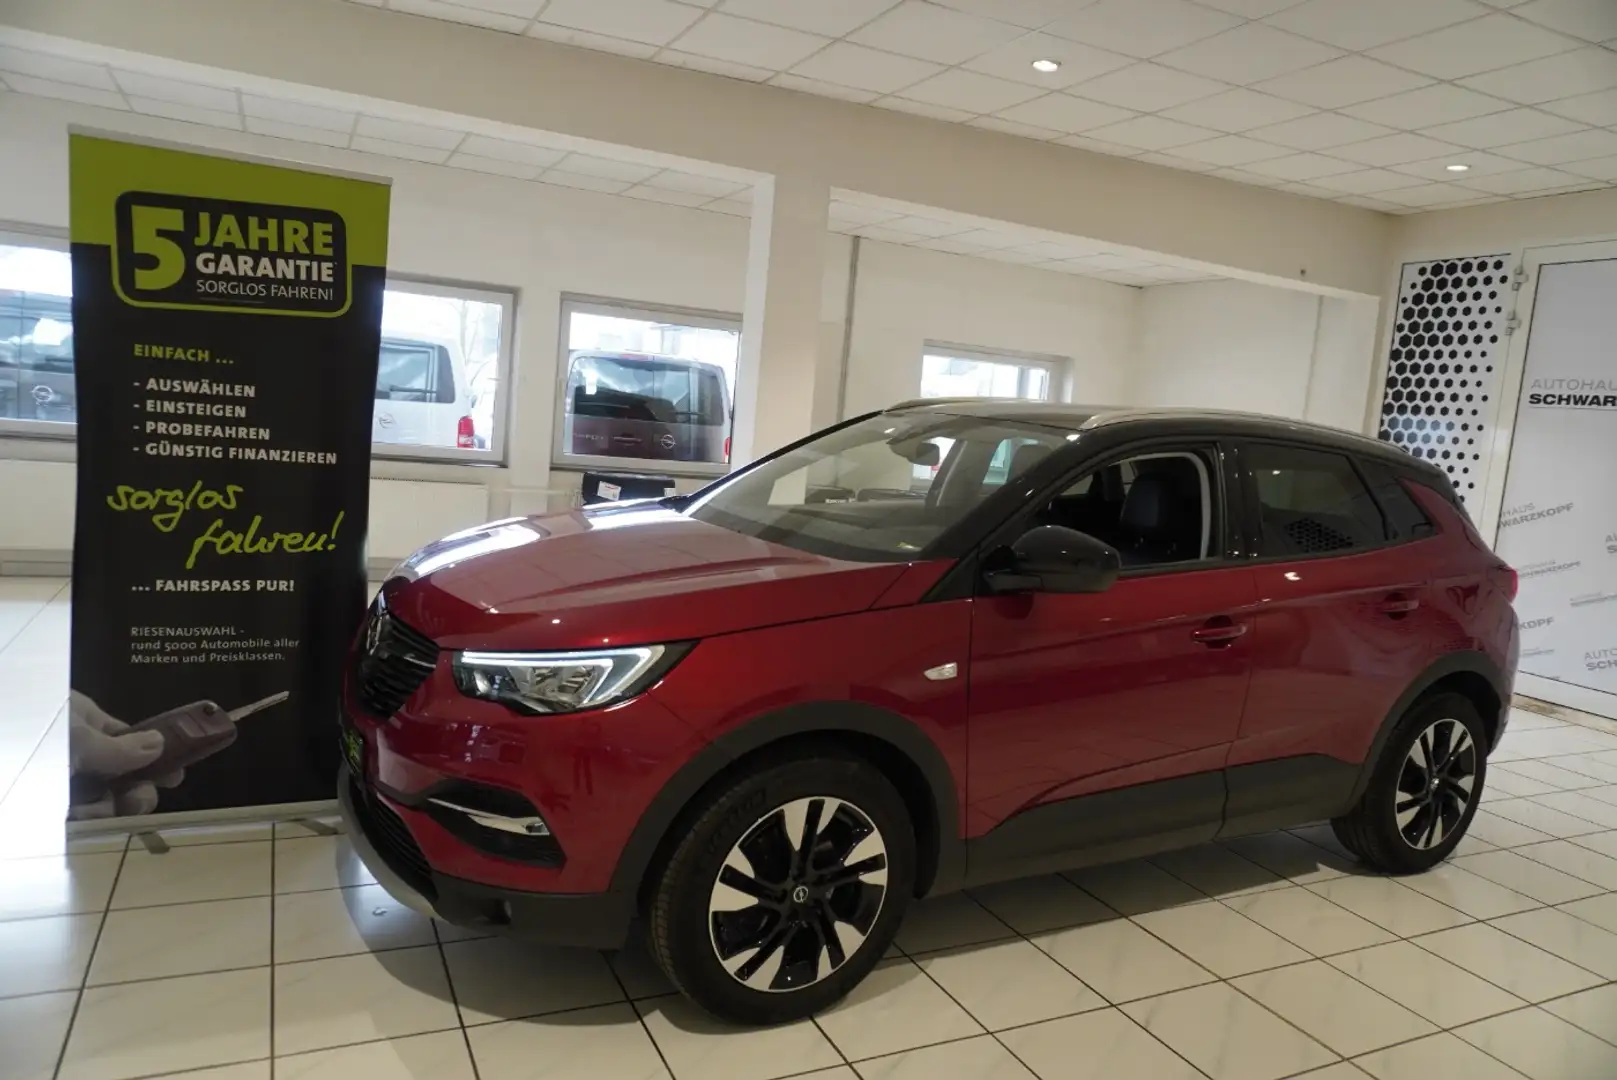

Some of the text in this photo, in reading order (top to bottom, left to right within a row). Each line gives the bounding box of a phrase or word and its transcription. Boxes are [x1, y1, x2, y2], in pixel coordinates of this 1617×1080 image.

[132, 205, 334, 290] 5 JAHRE
[196, 253, 333, 283] GARANTIE
[197, 280, 332, 300] SORGLOS FAHREN!
[134, 344, 209, 362] EINFACH
[146, 378, 255, 397] AUSWÄHLEN
[147, 400, 245, 417] EINSTEIGEN
[146, 421, 269, 441] PROBEFAHREN
[146, 440, 222, 458] GÜNSTIG
[229, 448, 336, 464] FINANZIEREN
[107, 480, 243, 534] sorglos
[186, 511, 344, 569] fahren!
[156, 580, 250, 591] FAHRSPASS
[257, 580, 294, 591] PUR!
[132, 627, 236, 636] RIESENAUSWAHL
[132, 638, 299, 651] rund 5000 Automobile aller
[131, 652, 284, 663] Marken und Preisklassen.
